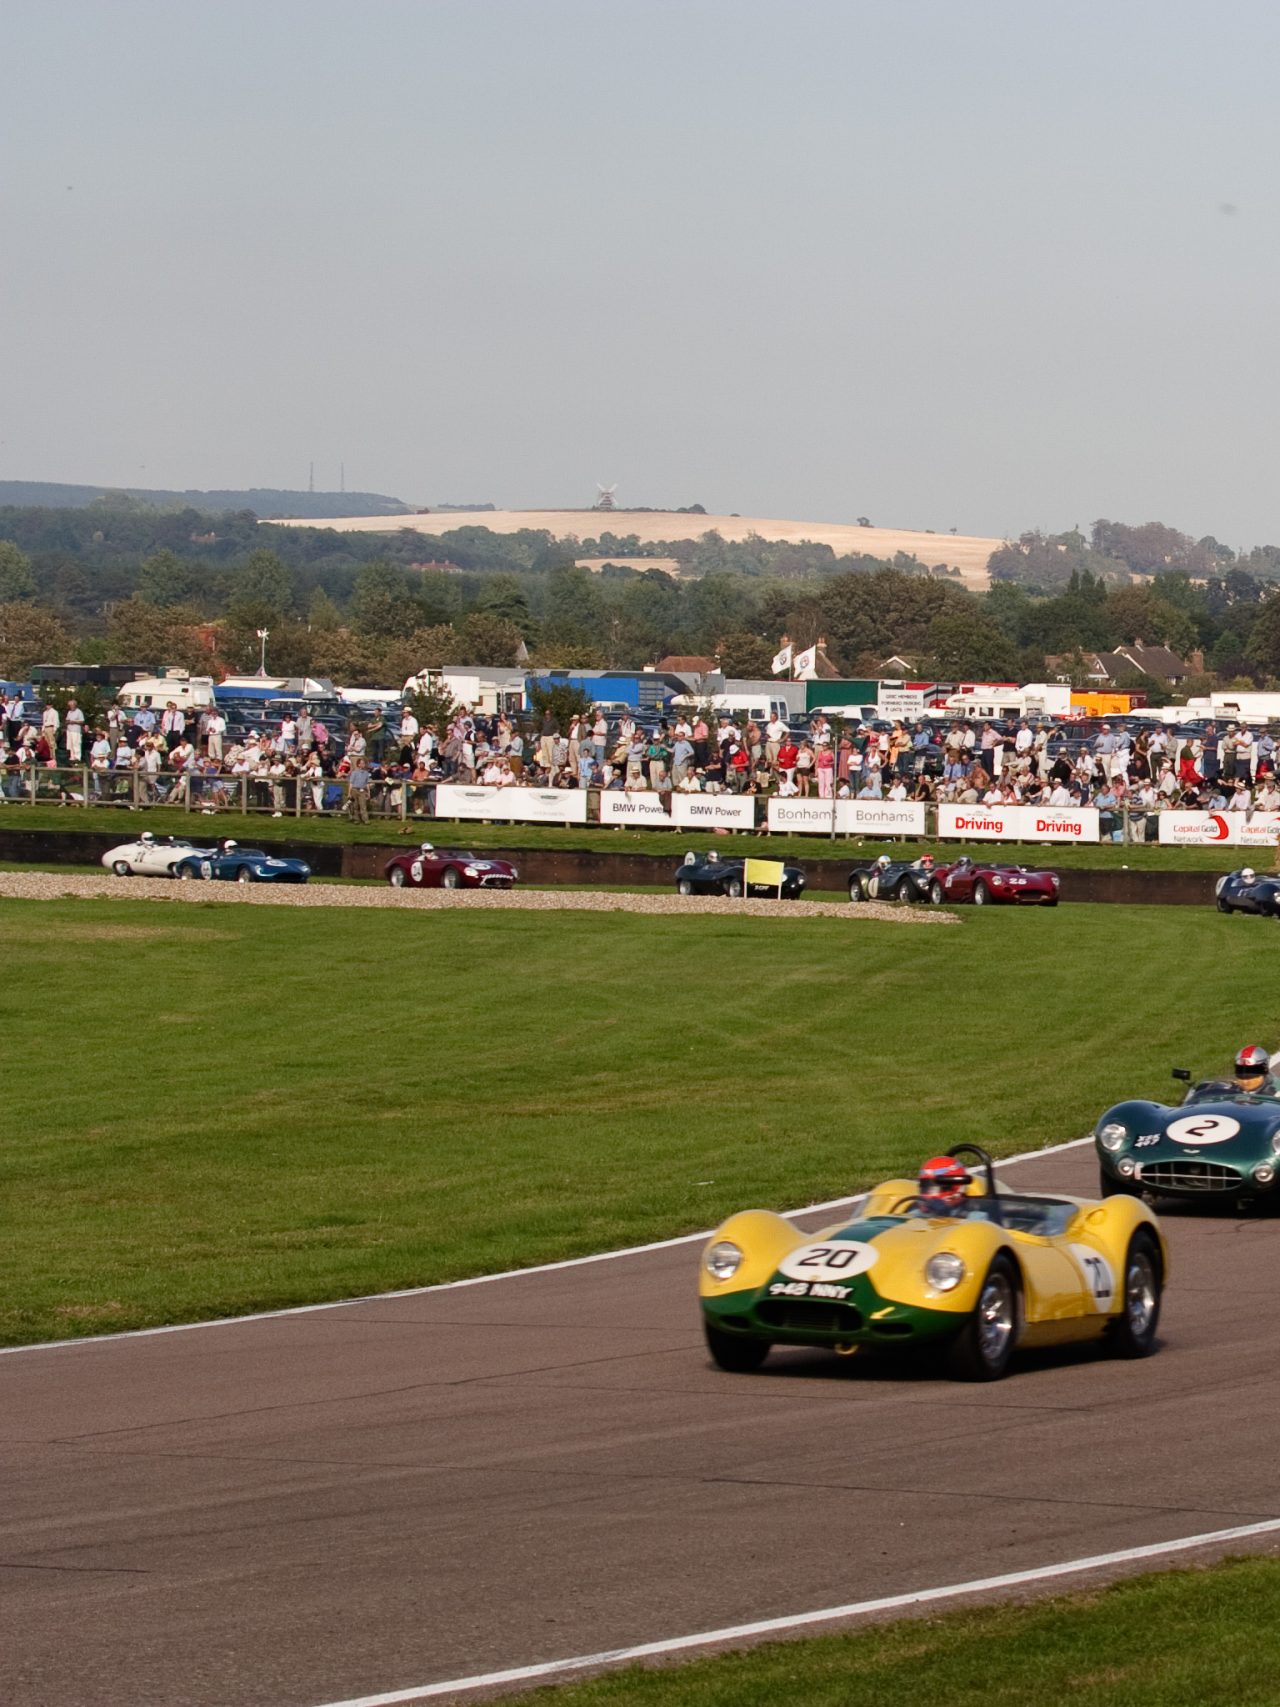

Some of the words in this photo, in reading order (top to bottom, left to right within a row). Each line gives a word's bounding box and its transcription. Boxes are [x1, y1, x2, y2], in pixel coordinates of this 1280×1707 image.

[612, 803, 636, 812] BMW
[639, 804, 664, 813] Powe
[690, 806, 712, 815] BMW
[715, 807, 742, 816] Power
[856, 810, 915, 822] Bonhams
[955, 817, 1004, 833] Driving
[1036, 820, 1082, 835] Driving
[1174, 825, 1200, 833] Capital
[1201, 824, 1218, 832] Gold
[1241, 825, 1266, 834] Capital
[1185, 1120, 1219, 1137] 2
[797, 1248, 859, 1268] 20
